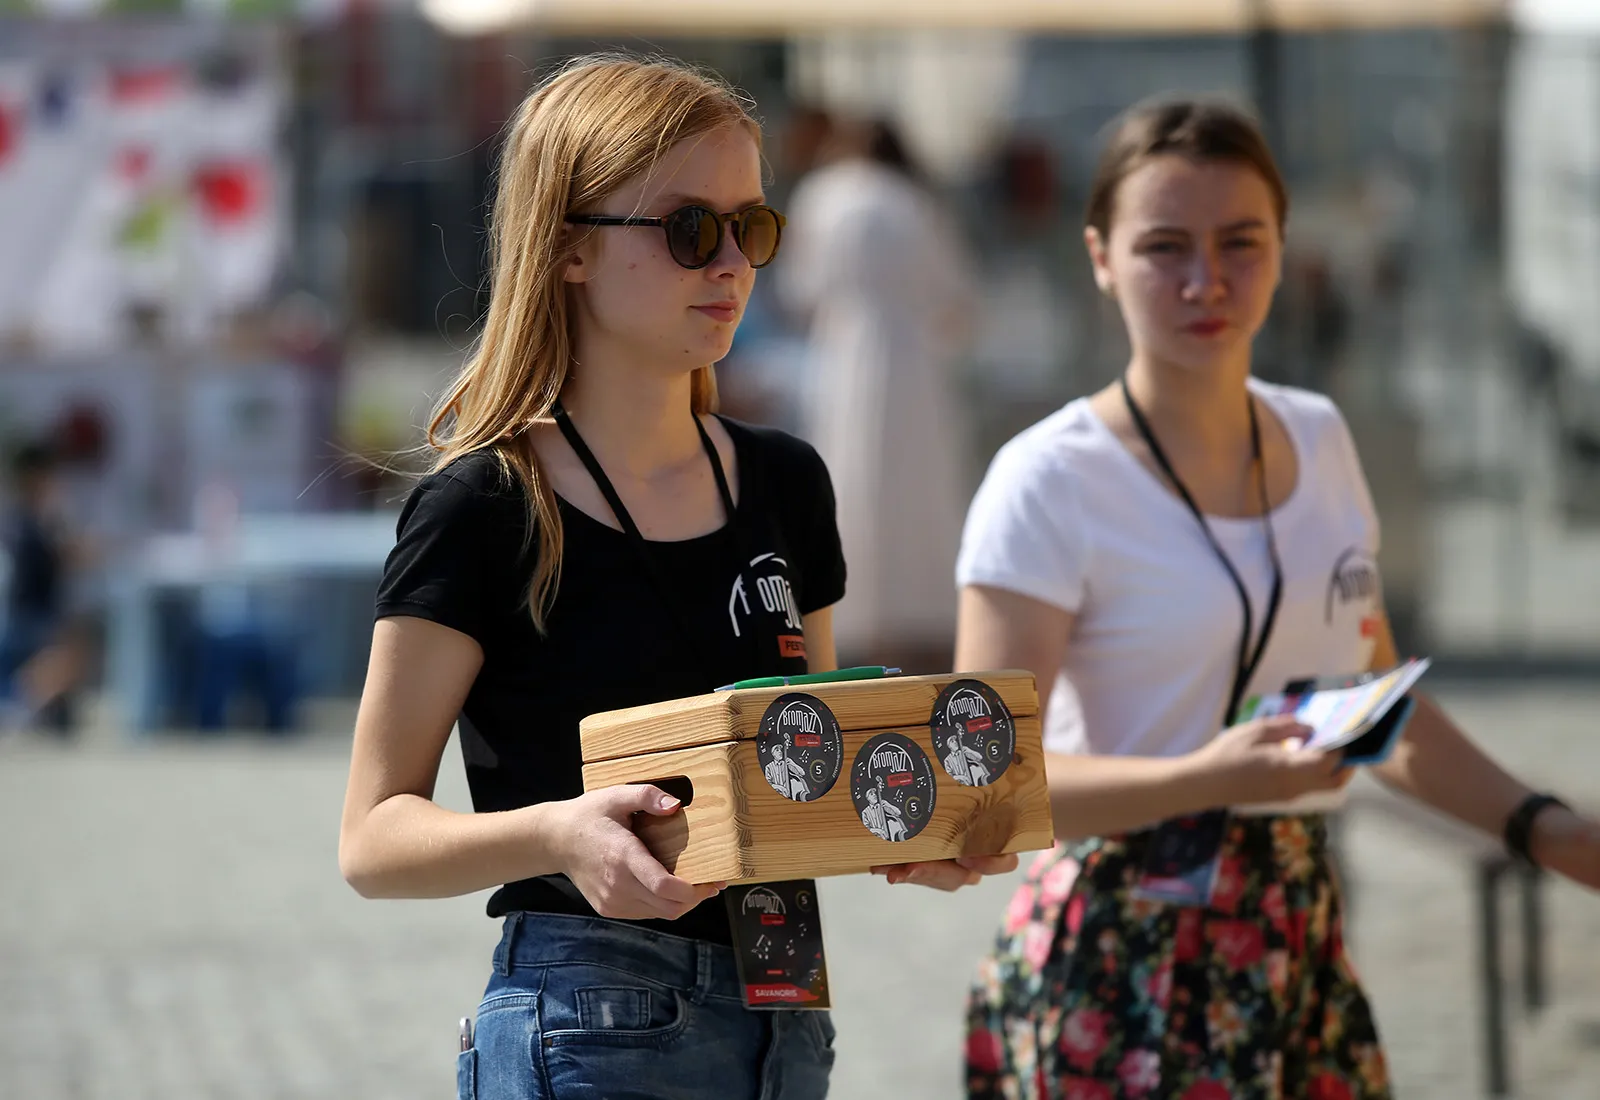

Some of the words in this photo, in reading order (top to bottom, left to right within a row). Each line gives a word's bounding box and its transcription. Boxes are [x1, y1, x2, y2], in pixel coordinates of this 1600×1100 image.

[991, 745, 998, 755] 5
[815, 765, 822, 775] 5
[910, 802, 917, 812] 5
